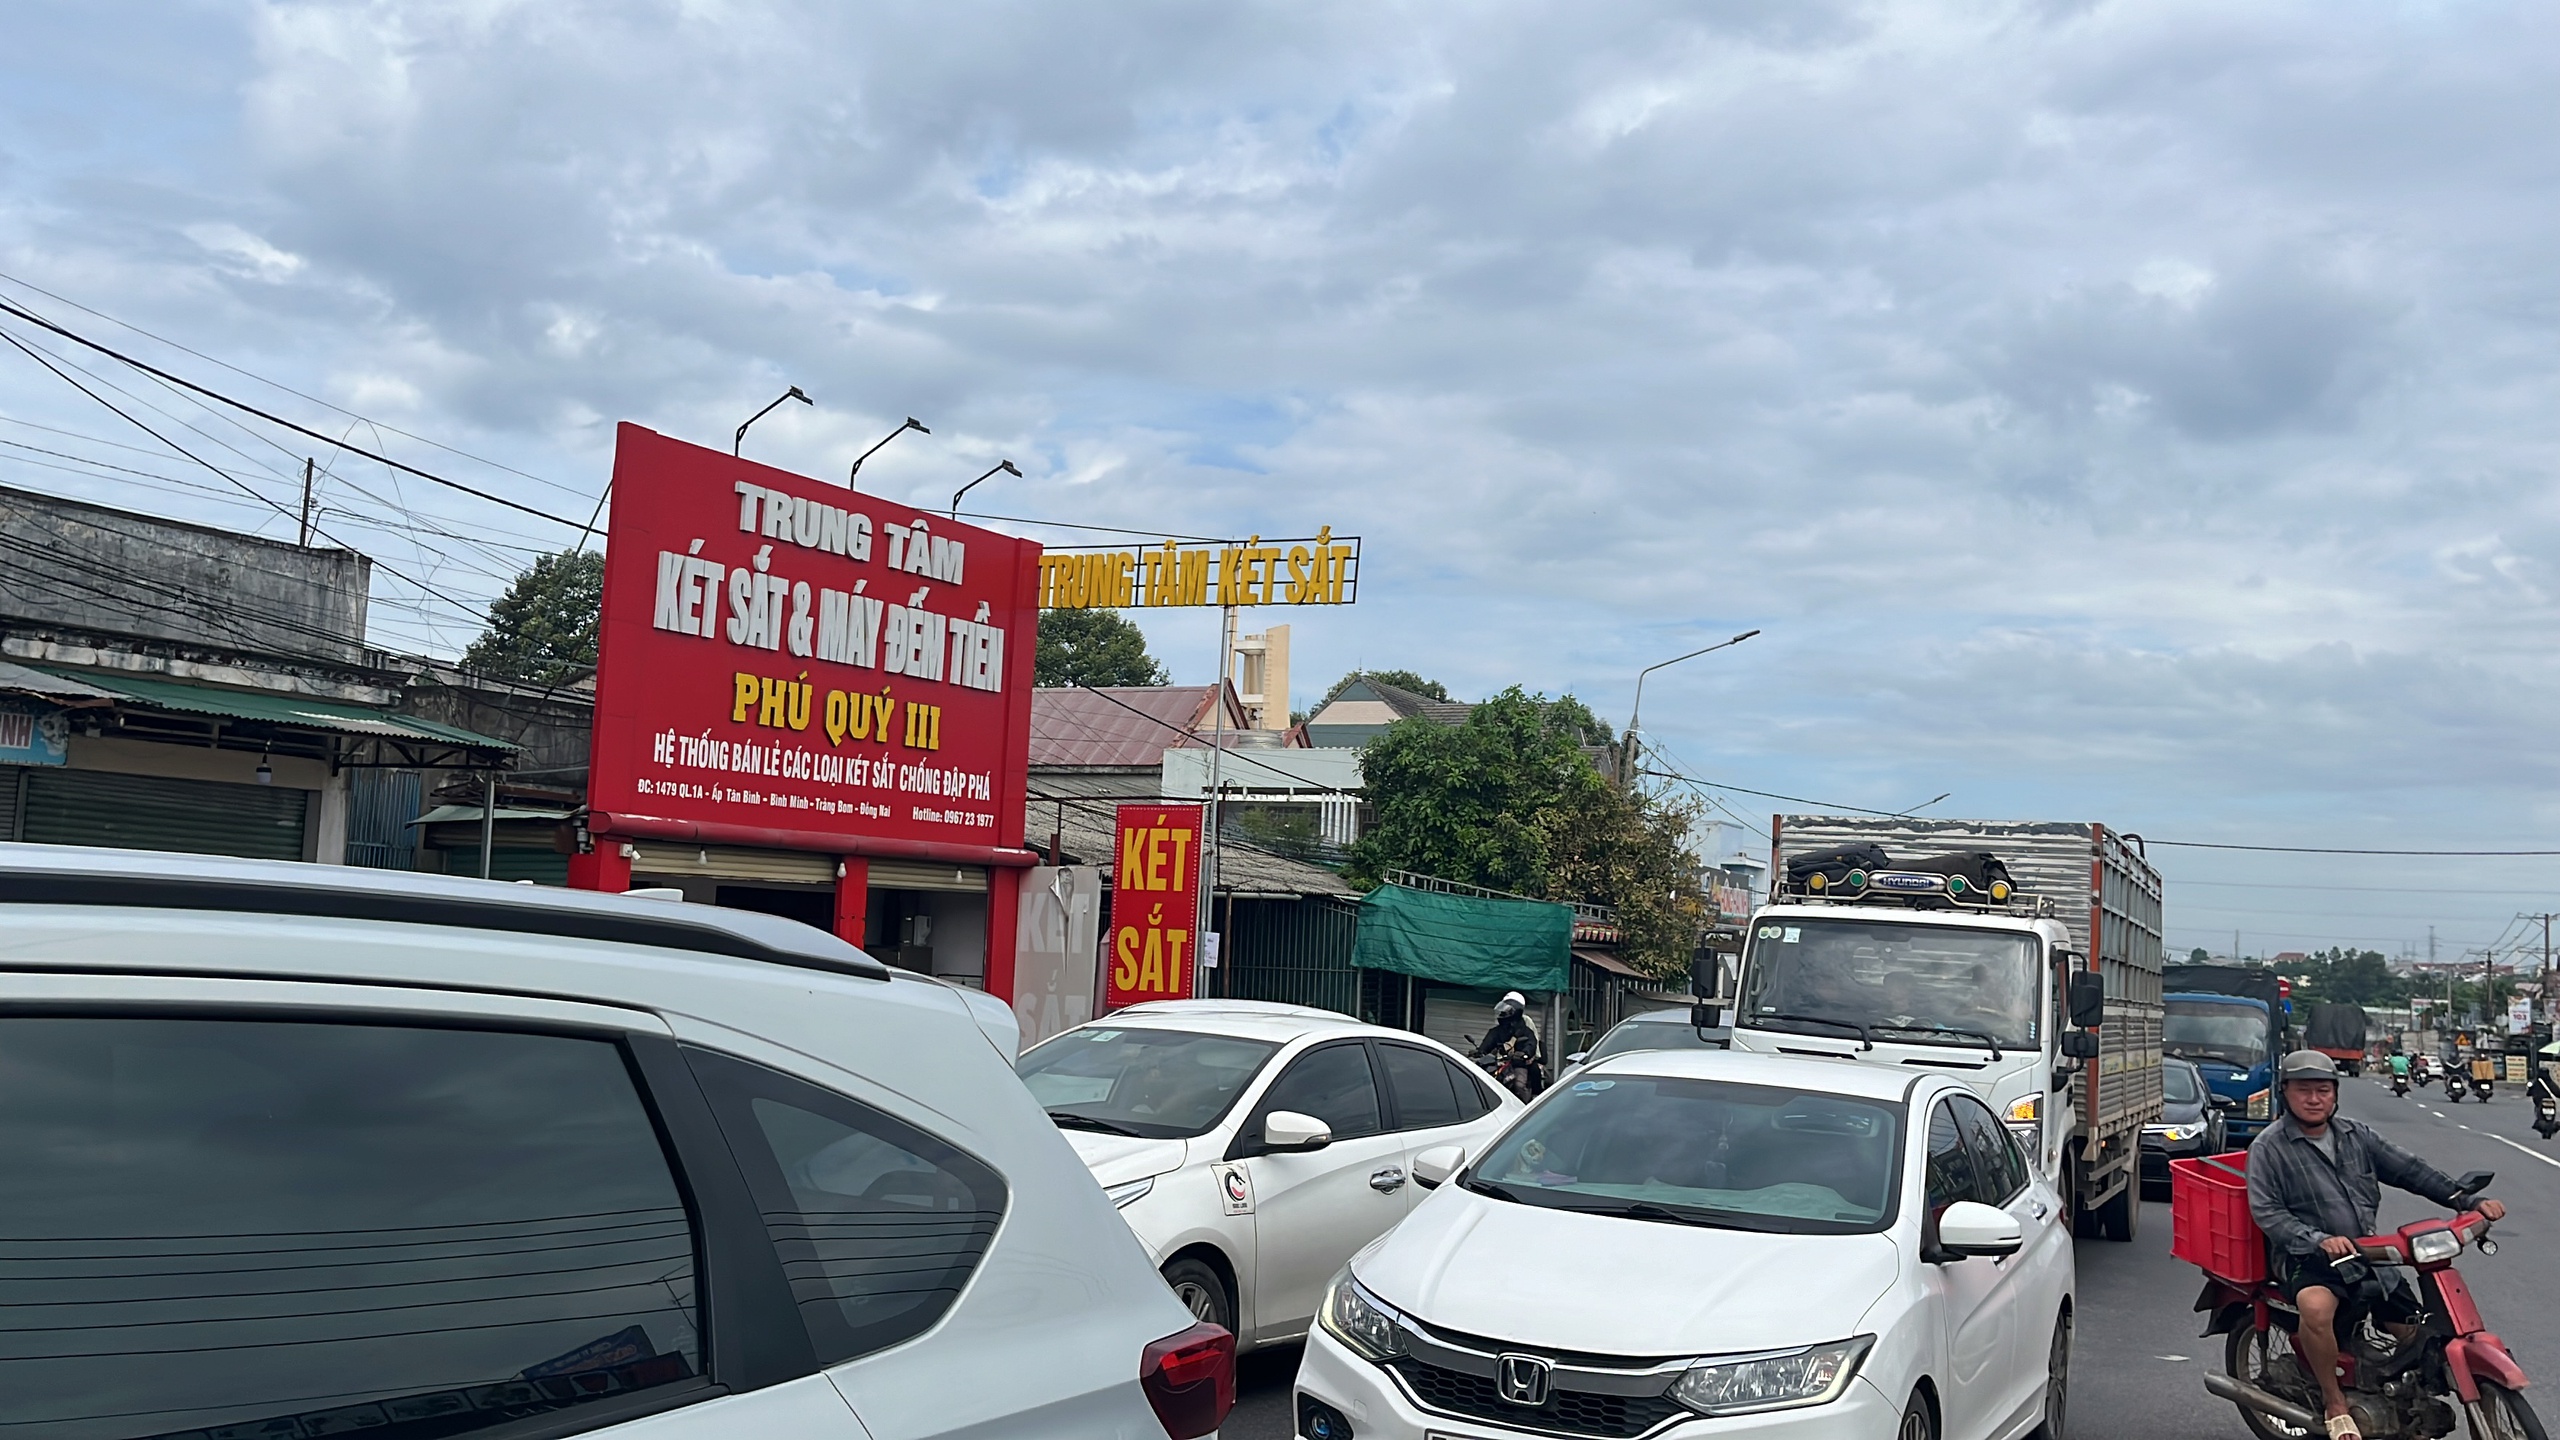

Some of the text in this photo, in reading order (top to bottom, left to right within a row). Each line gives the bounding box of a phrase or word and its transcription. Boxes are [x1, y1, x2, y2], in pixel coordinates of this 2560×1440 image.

[735, 480, 965, 586] TRUNG TÂM
[1039, 525, 1352, 609] TRUNG TÂM KÉT SẮT
[653, 538, 1005, 693] KÉT SẮT & MÁY ĐẾM TIỀN
[0, 713, 32, 748] NH
[731, 670, 941, 750] PHÚ QUÝ III
[637, 778, 654, 794] ĐC:
[655, 780, 677, 797] 1479
[679, 783, 704, 799] QL.1A
[726, 788, 741, 803] Tân
[789, 794, 809, 810] Minh
[837, 799, 853, 814] Bom
[878, 804, 891, 818] Nai
[654, 728, 991, 803] HỆ THỐNG BÁN LẺ CÁC LOẠI KÉT SẮT CHỐNG ĐẬP PHÁ
[912, 806, 995, 828] Hotline: 0967 23 1977
[1121, 814, 1192, 892] KÉT
[1883, 877, 1930, 888] HYUNDAI
[1115, 903, 1188, 993] SẮT
